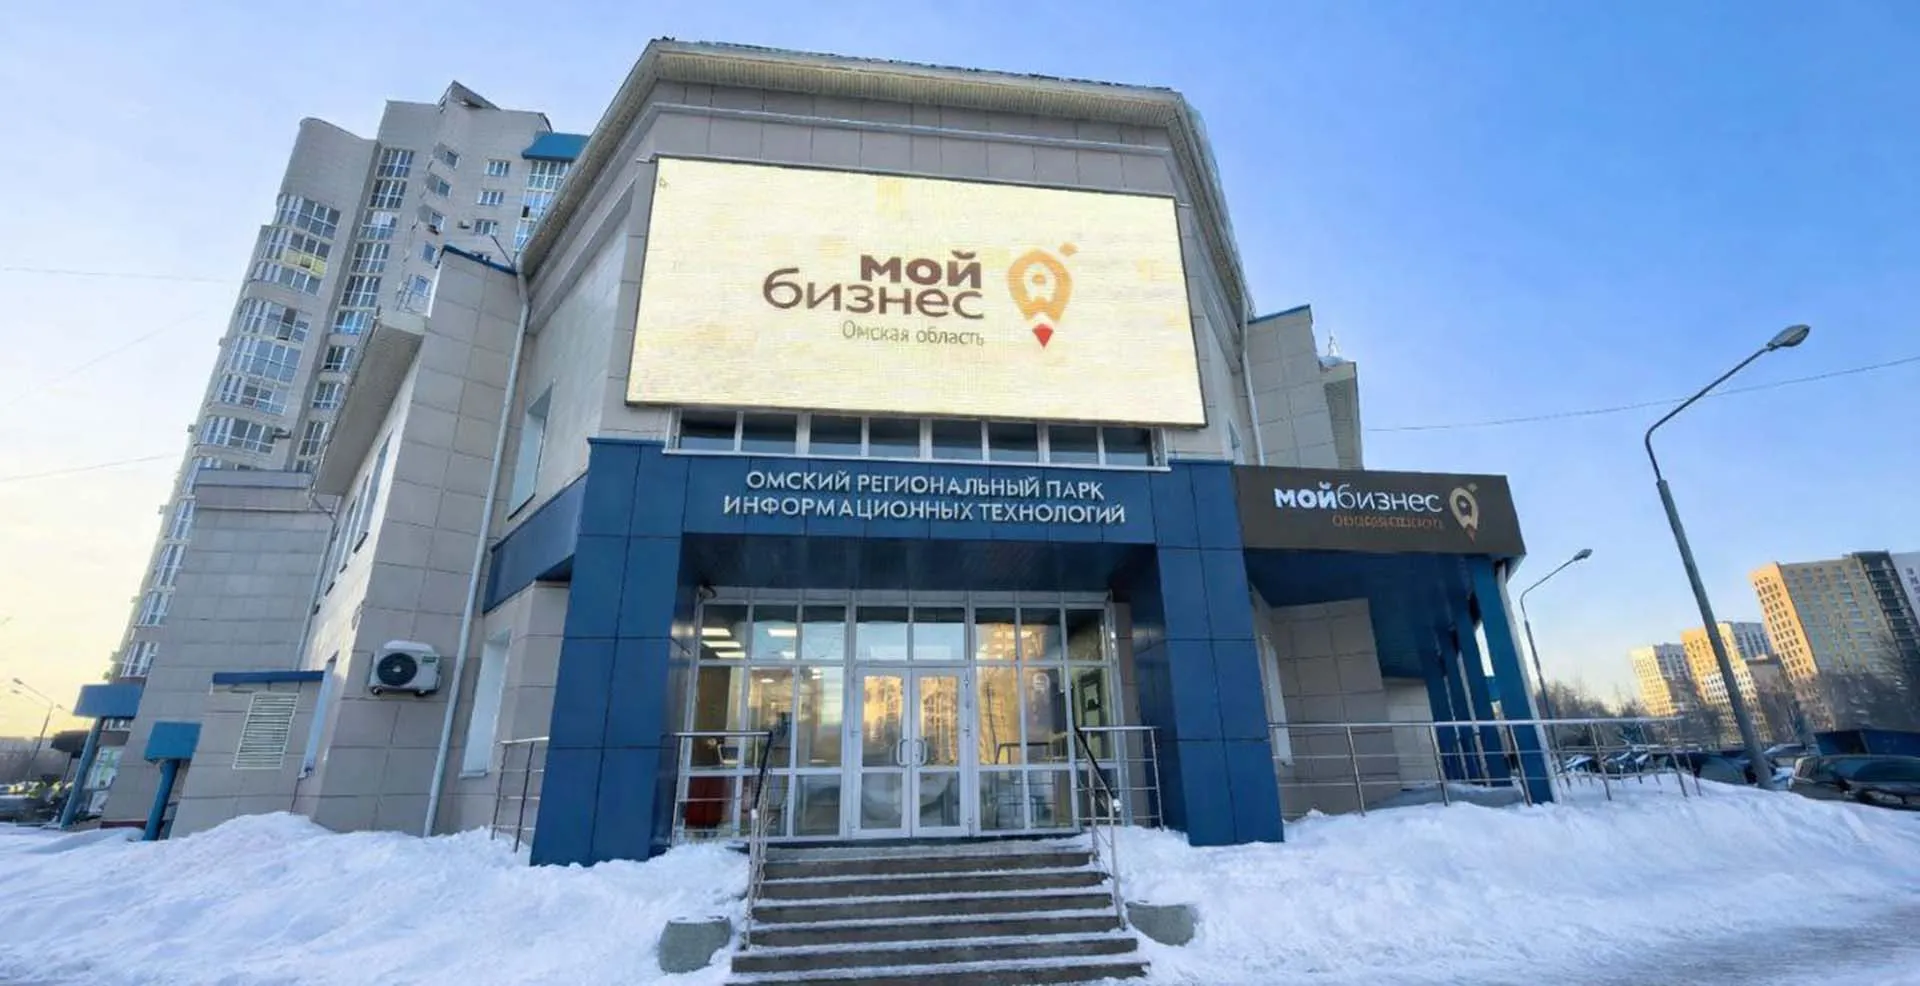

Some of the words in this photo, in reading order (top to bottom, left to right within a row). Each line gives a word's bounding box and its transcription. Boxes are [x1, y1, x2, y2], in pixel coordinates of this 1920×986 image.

[763, 267, 985, 319] бизнес
[842, 320, 909, 341] Омская
[915, 330, 985, 346] область
[746, 470, 850, 491] ОМСКИЙ
[857, 474, 1040, 499] РЕГИОНАЛЬНЫЙ
[1046, 481, 1104, 501] ПАРК
[723, 495, 973, 521] ИНФОРМАЦИОННЫХ
[979, 504, 1126, 524] ТЕХНОЛОГИЙ
